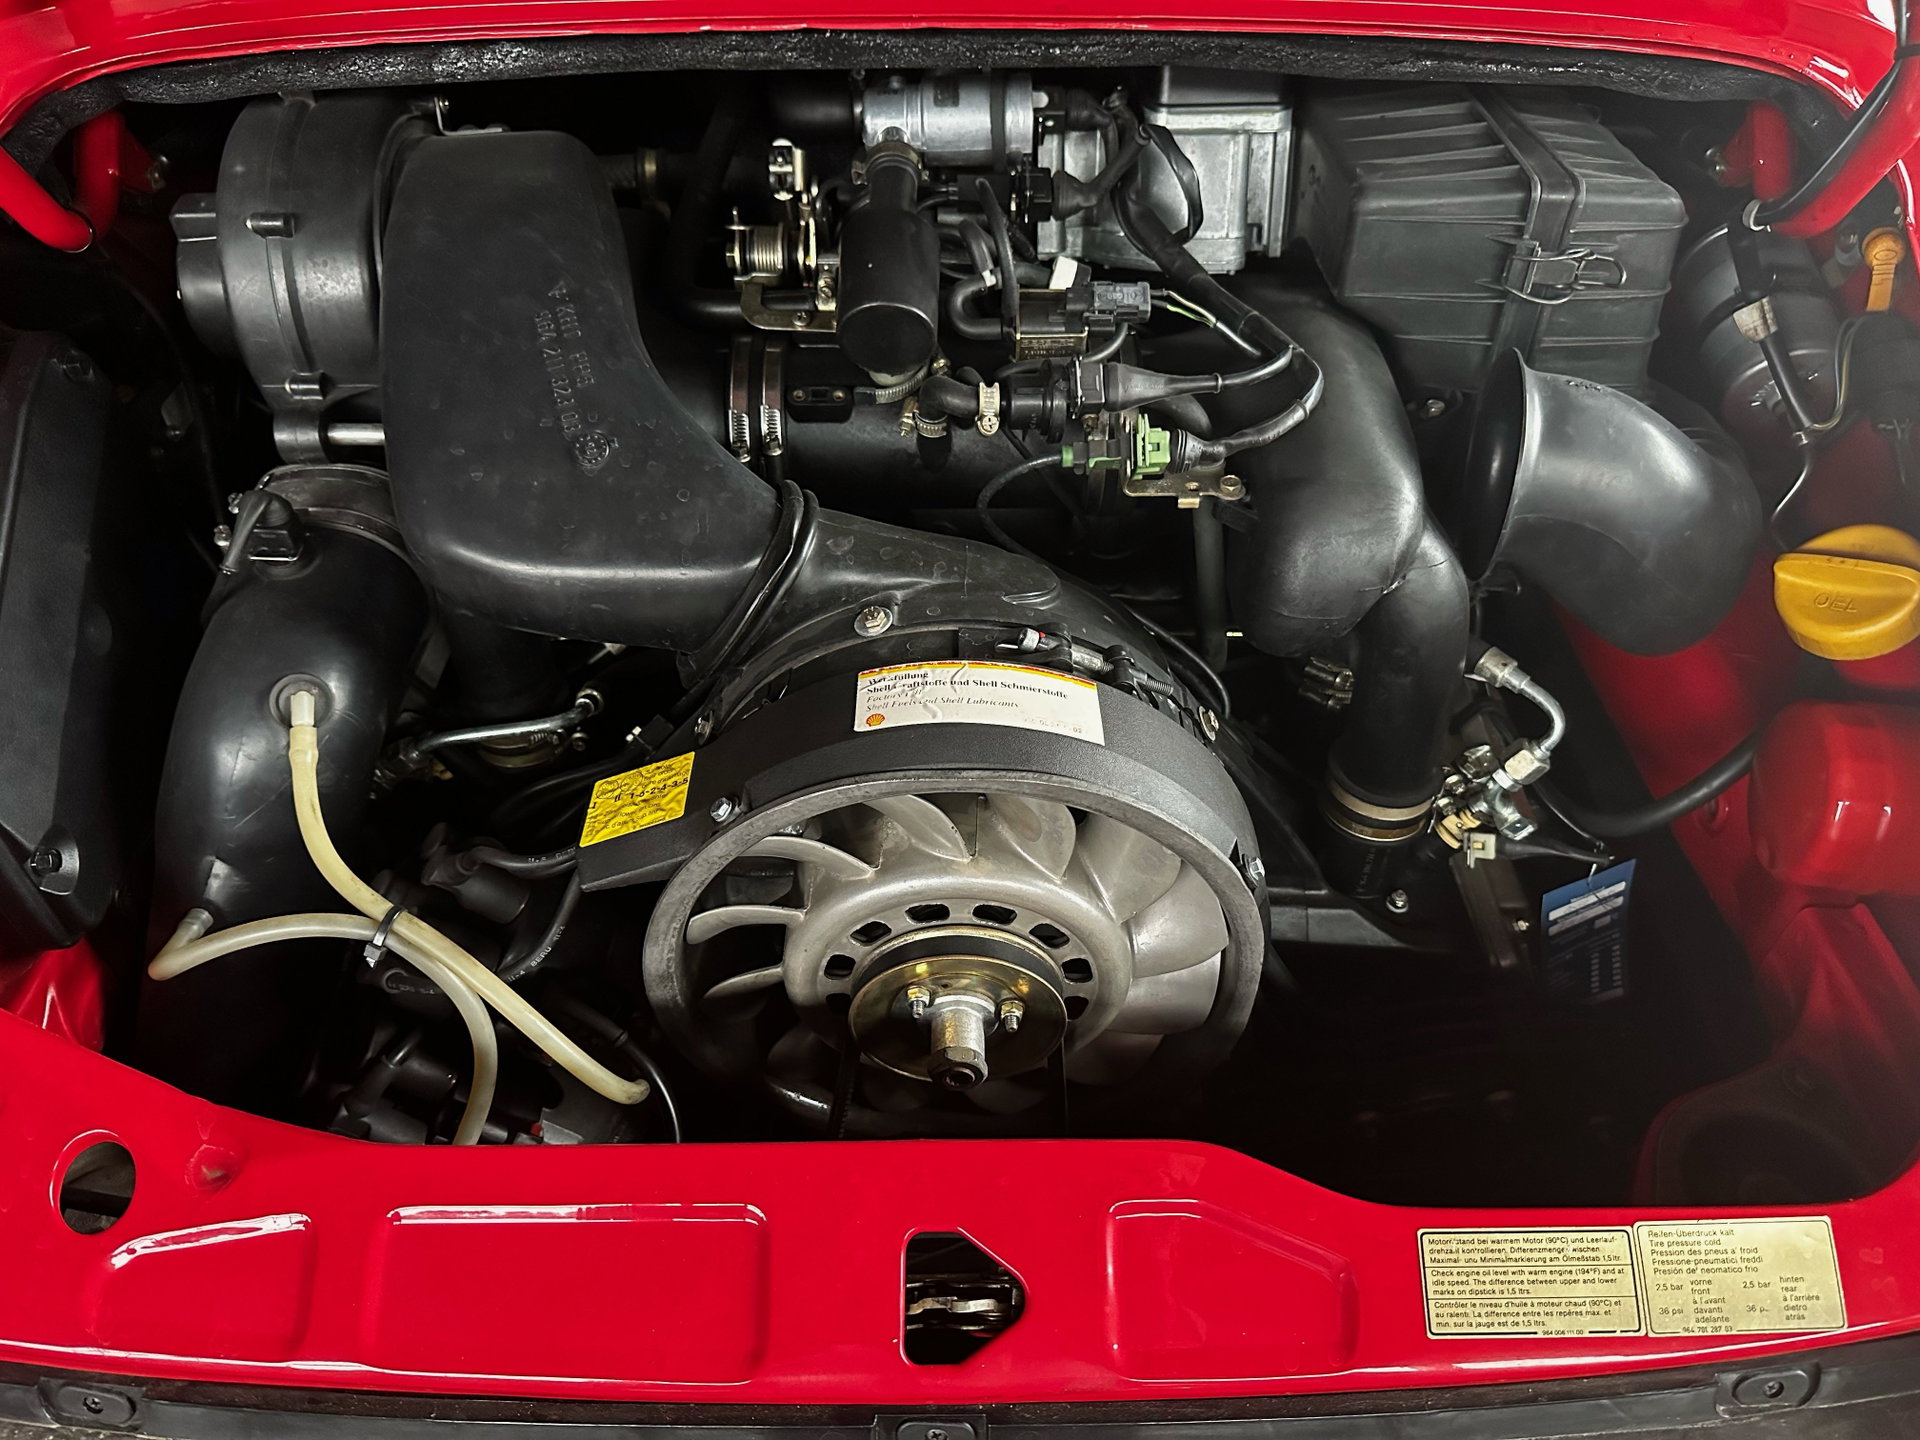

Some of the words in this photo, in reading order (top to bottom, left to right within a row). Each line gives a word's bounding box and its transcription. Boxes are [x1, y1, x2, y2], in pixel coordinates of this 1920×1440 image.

[551, 375, 575, 407] 323
[1814, 591, 1857, 613] OEL
[867, 672, 929, 686] Wersfüllung
[972, 679, 998, 688] Shell
[1000, 681, 1069, 699] Schmierstoffe
[865, 701, 889, 712] Shell
[891, 699, 917, 708] Fuels
[966, 697, 1019, 709] Lubricants
[529, 945, 552, 967] BERU
[1719, 1229, 1735, 1237] kalt
[1570, 1236, 1585, 1244] und
[1586, 1236, 1618, 1244] Leerlauf-
[1649, 1239, 1665, 1248] Tire
[1667, 1240, 1702, 1248] pressure
[1704, 1238, 1722, 1246] cold
[1650, 1248, 1685, 1257] Pression
[1687, 1248, 1702, 1256] des
[1704, 1247, 1729, 1257] pneus
[1739, 1246, 1759, 1255] froid
[1562, 1254, 1600, 1263] Ölmeßstab
[1739, 1256, 1764, 1264] freddi
[1430, 1269, 1454, 1277] Check
[1456, 1270, 1480, 1278] engine
[1549, 1268, 1573, 1276] engine
[1602, 1267, 1616, 1275] and
[1617, 1267, 1625, 1275] at
[1653, 1266, 1684, 1275] Presión
[1700, 1265, 1743, 1275] neomatico
[1431, 1278, 1445, 1286] idle
[1473, 1278, 1487, 1286] The
[1488, 1278, 1525, 1286] difference
[1527, 1277, 1558, 1286] between
[1559, 1278, 1580, 1287] upper
[1582, 1277, 1596, 1285] and
[1778, 1275, 1805, 1283] hinten
[1670, 1283, 1684, 1291] bar
[1757, 1280, 1771, 1289] bar
[1468, 1288, 1497, 1296] dipstick
[1506, 1288, 1517, 1296] 1,5
[1690, 1287, 1711, 1295] front
[1789, 1293, 1820, 1302] l'arrière
[1434, 1301, 1468, 1309] Contrôler
[1504, 1300, 1529, 1308] d'huile
[1745, 1304, 1757, 1313] 36
[1783, 1304, 1808, 1312] dietro
[1555, 1309, 1583, 1317] repères
[1658, 1306, 1670, 1315] 36
[1671, 1307, 1684, 1316] psi
[1693, 1306, 1724, 1314] davanti
[1694, 1316, 1730, 1324] adelante
[1784, 1313, 1806, 1321] atrás
[1475, 1320, 1495, 1328] jauge
[1510, 1319, 1520, 1327] de
[1521, 1319, 1532, 1327] 1,5
